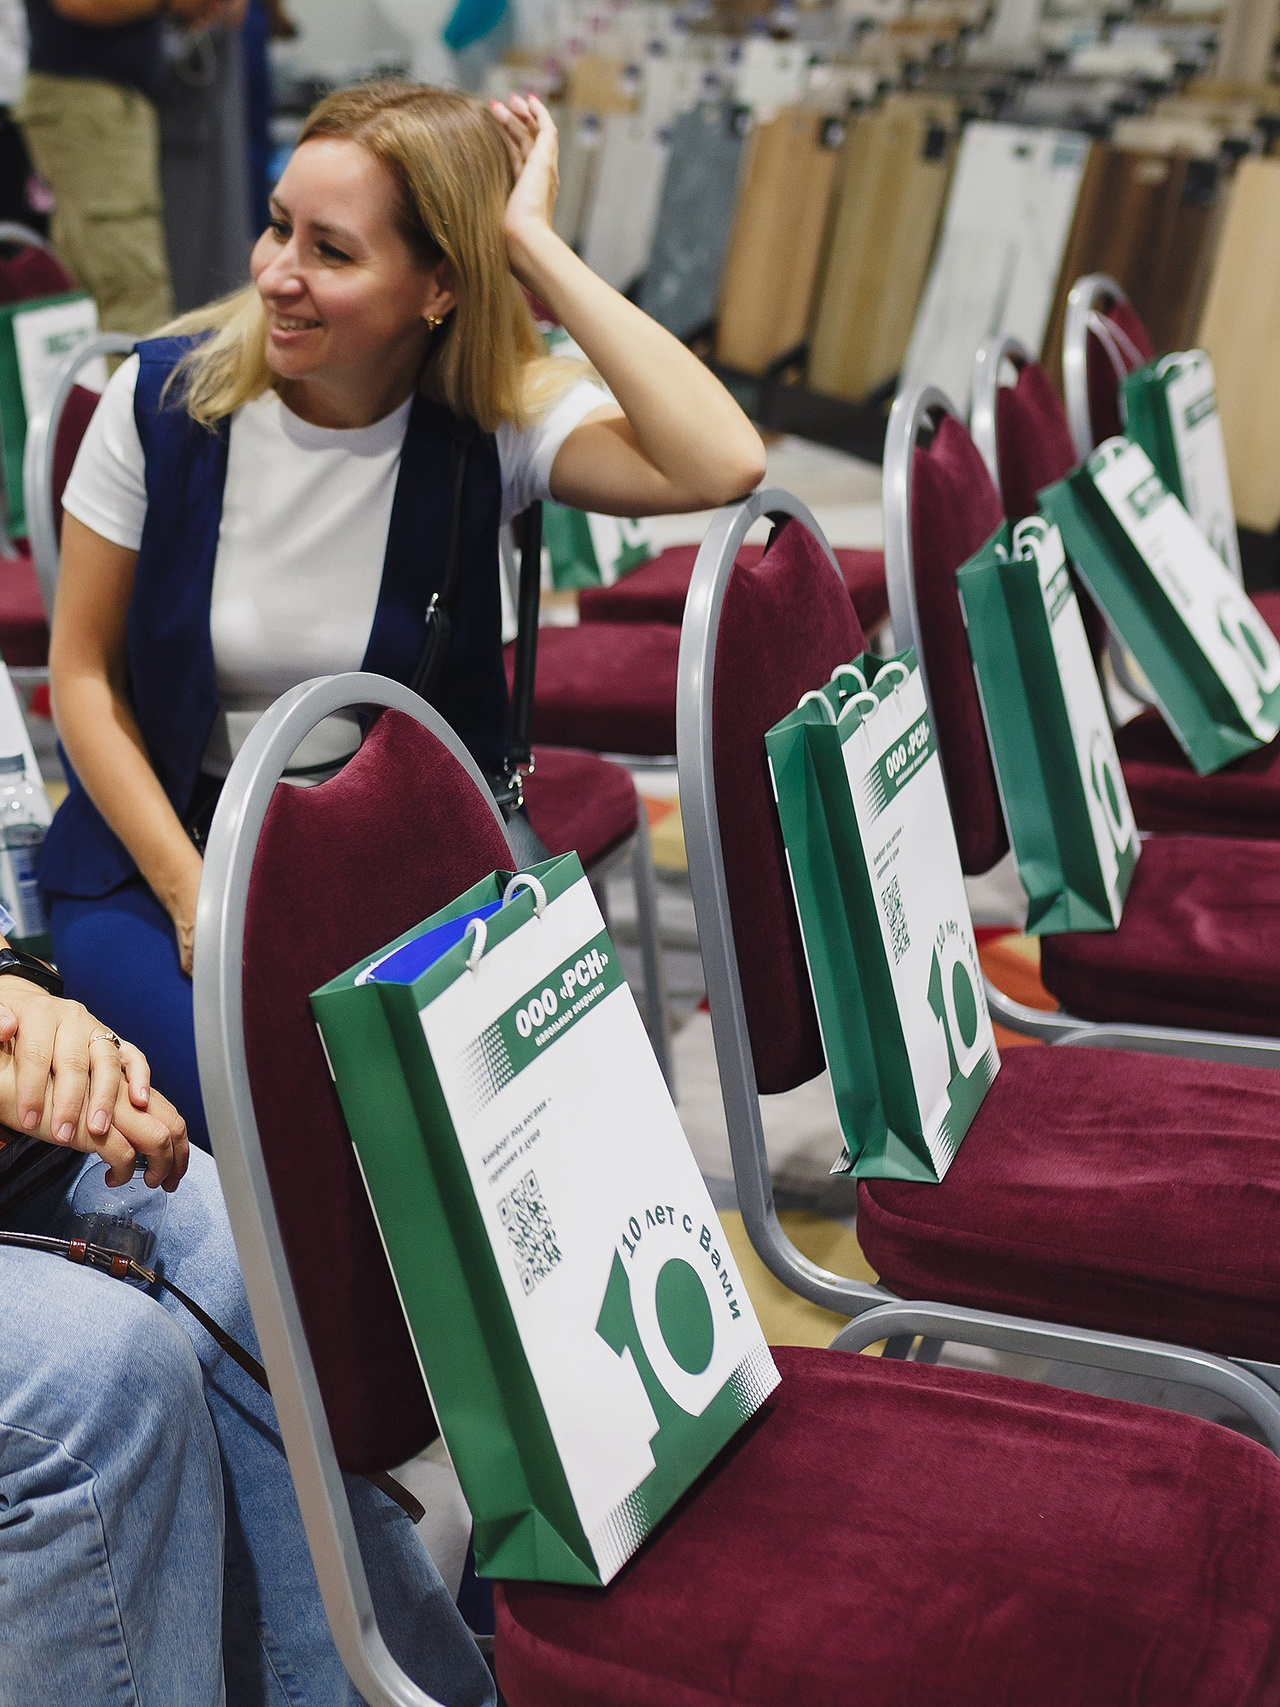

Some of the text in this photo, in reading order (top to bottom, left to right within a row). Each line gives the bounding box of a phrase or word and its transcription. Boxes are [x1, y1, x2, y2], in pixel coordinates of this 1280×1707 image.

[515, 948, 609, 1037] ООО «РСН»
[622, 1204, 741, 1320] 10 лет с Вами
[595, 1246, 722, 1446] 10
